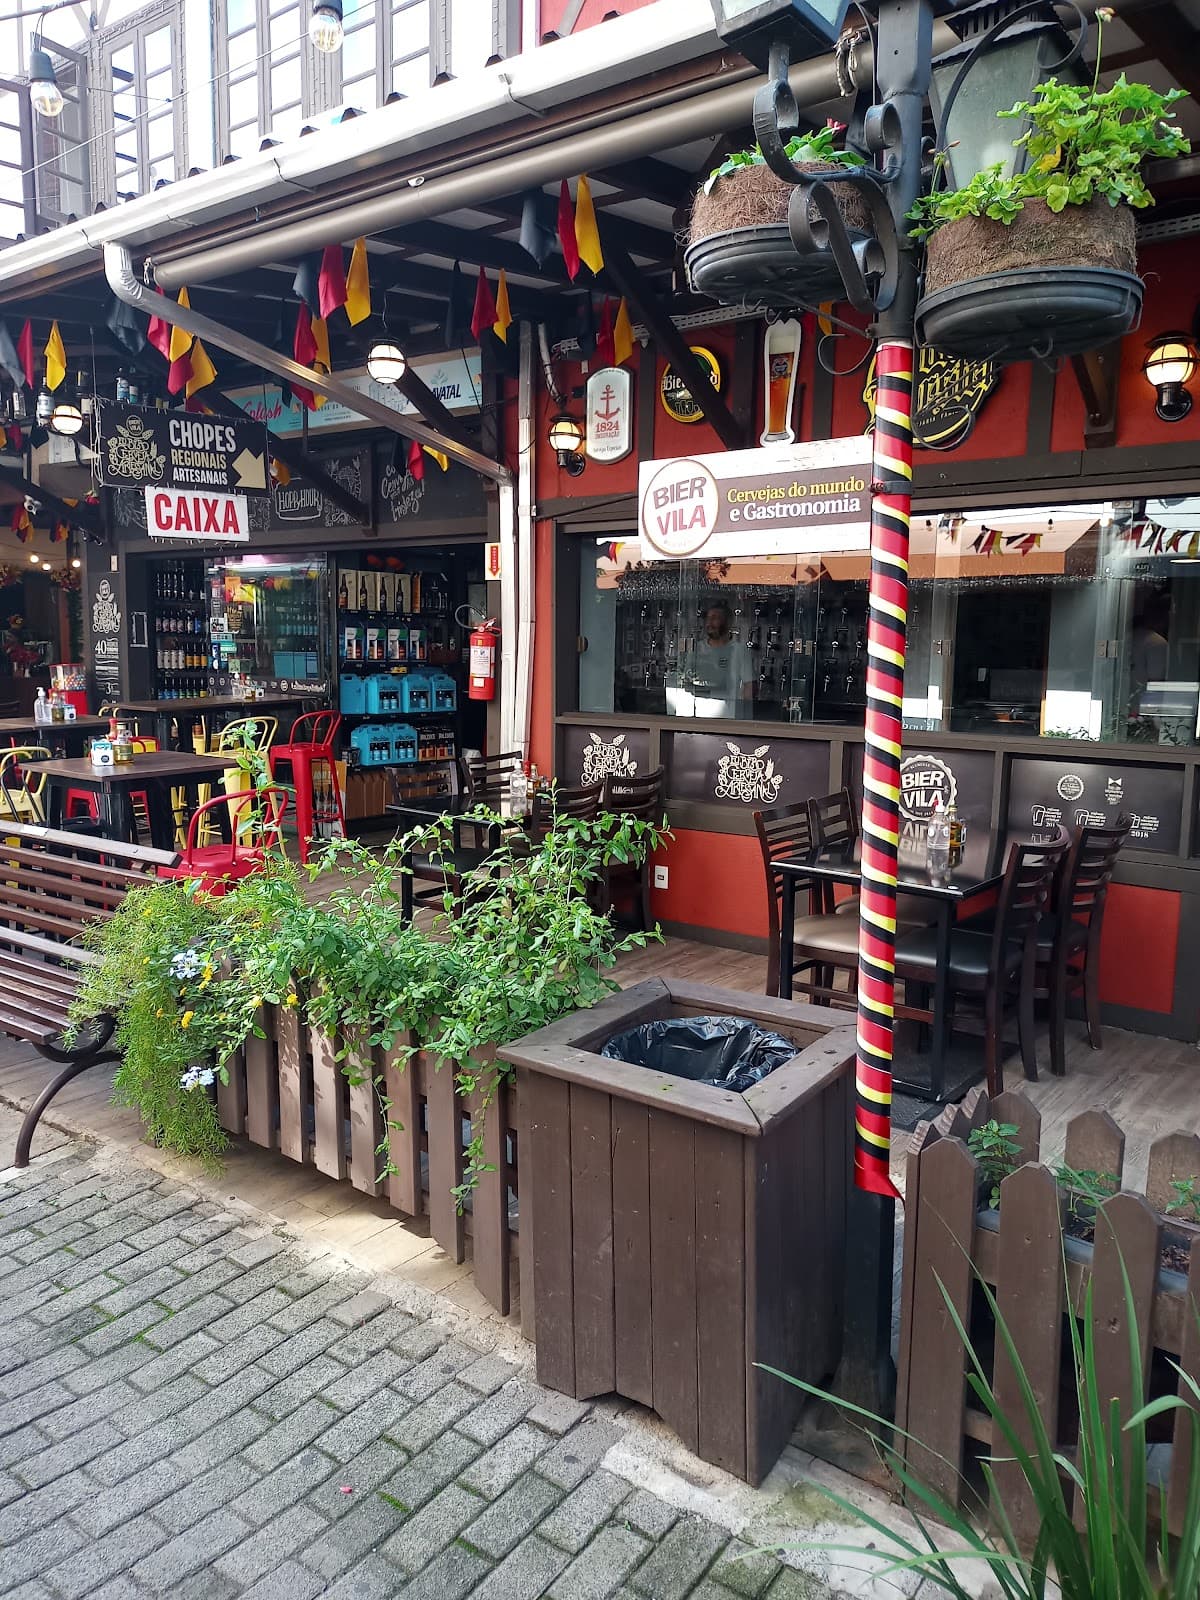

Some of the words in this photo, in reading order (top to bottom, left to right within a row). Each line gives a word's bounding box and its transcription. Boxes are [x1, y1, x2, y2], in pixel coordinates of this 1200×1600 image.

[169, 420, 236, 452] CHOPES
[595, 421, 620, 433] 1824
[170, 448, 227, 470] REGIONAIS
[172, 468, 228, 485] ARTESANAIS
[727, 484, 786, 503] Cervejas
[788, 481, 807, 498] do
[810, 475, 865, 496] mundo
[653, 476, 707, 509] BIER
[154, 494, 240, 534] CAIXA
[729, 507, 741, 522] e
[743, 493, 861, 521] Gastronomia
[657, 505, 706, 536] VILA
[95, 640, 106, 655] 40
[902, 770, 945, 789] BIER
[904, 790, 944, 809] VILA
